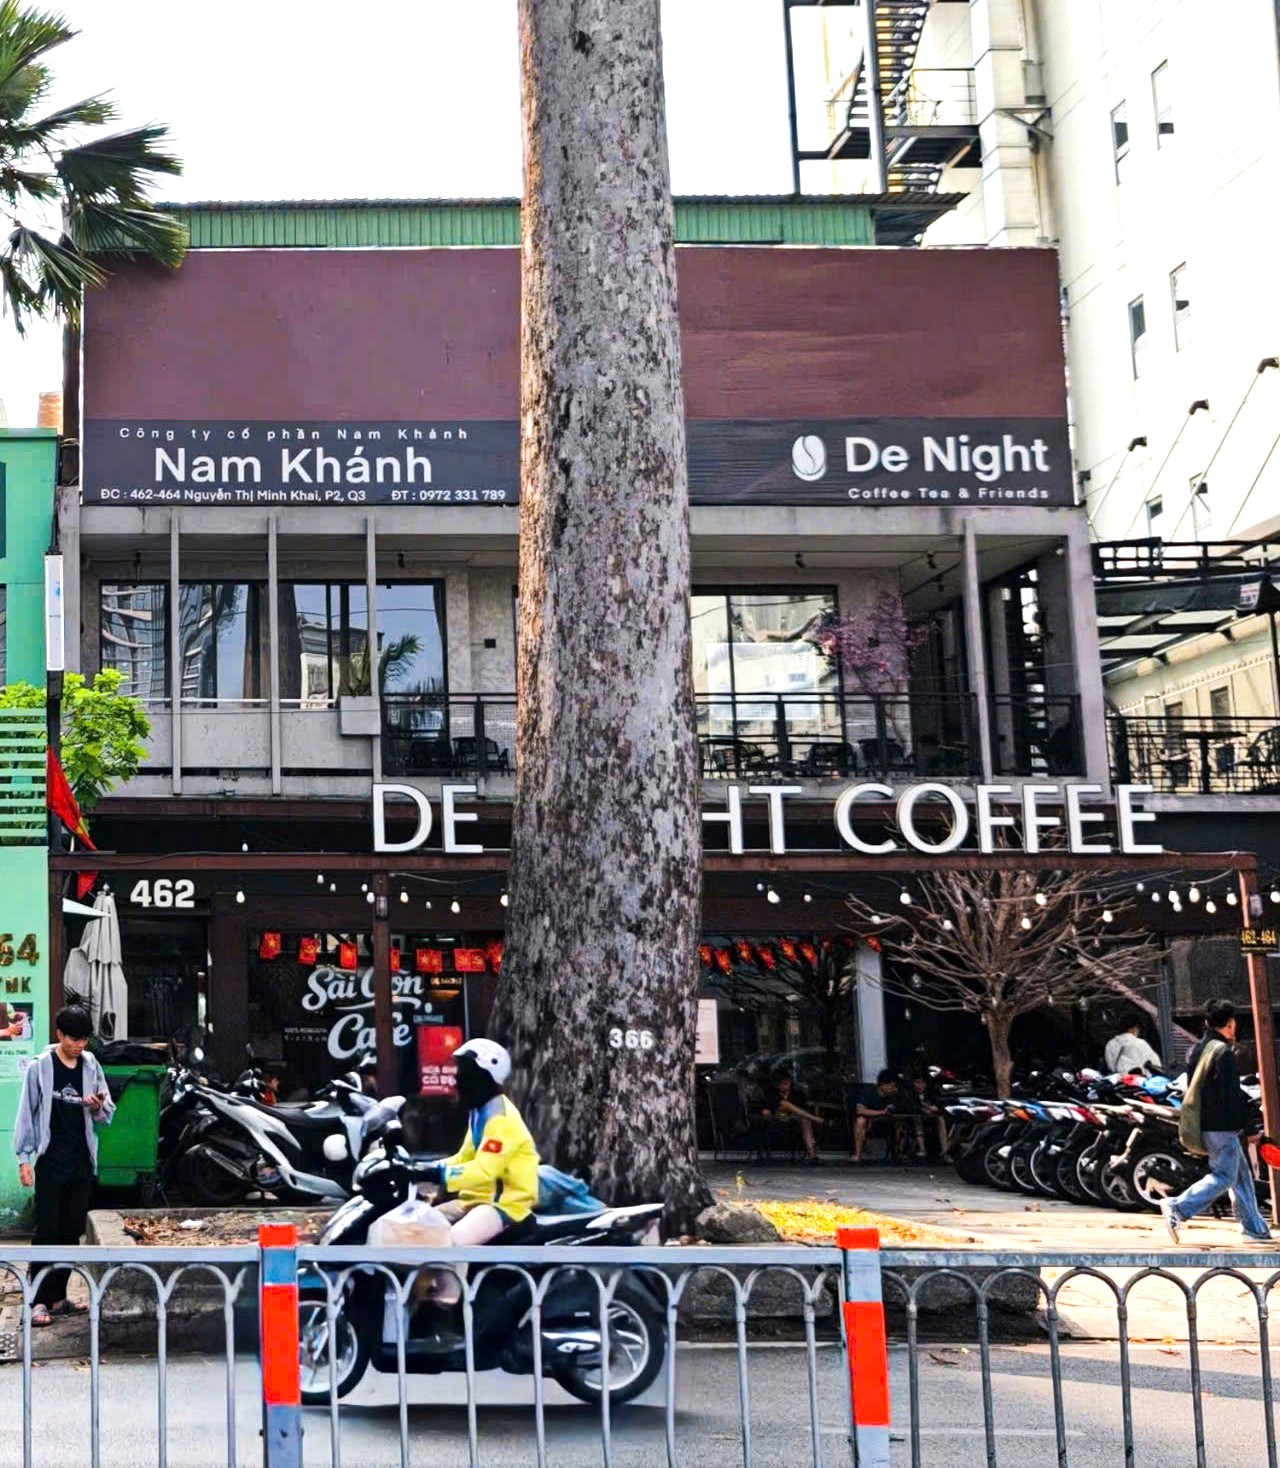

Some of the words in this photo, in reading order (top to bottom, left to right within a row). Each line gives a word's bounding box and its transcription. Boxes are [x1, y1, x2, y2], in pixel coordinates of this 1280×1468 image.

[120, 427, 174, 440] Công
[191, 429, 210, 440] ty
[338, 429, 381, 439] Nam
[398, 428, 467, 439] Khánh
[155, 447, 261, 482] Nam
[282, 445, 432, 482] Khánh
[845, 436, 910, 472] De
[923, 434, 1051, 482] Night
[100, 488, 120, 499] ĐC
[130, 488, 180, 499] 462-464
[184, 487, 231, 502] Nguyễn
[257, 489, 287, 500] Minh
[291, 489, 321, 502] Khai,
[325, 490, 344, 502] P2,
[348, 490, 366, 502] Q3
[420, 489, 451, 500] 0972
[455, 489, 478, 500] 331
[482, 489, 506, 500] 789
[848, 487, 910, 499] Coffee
[918, 487, 950, 499] Tea
[958, 487, 969, 499] &
[978, 487, 1049, 499] Friends
[372, 783, 484, 854] DE
[833, 782, 1163, 855] COFFEE
[130, 878, 195, 908] 462
[301, 966, 358, 1011] Sài
[609, 1028, 653, 1050] 366
